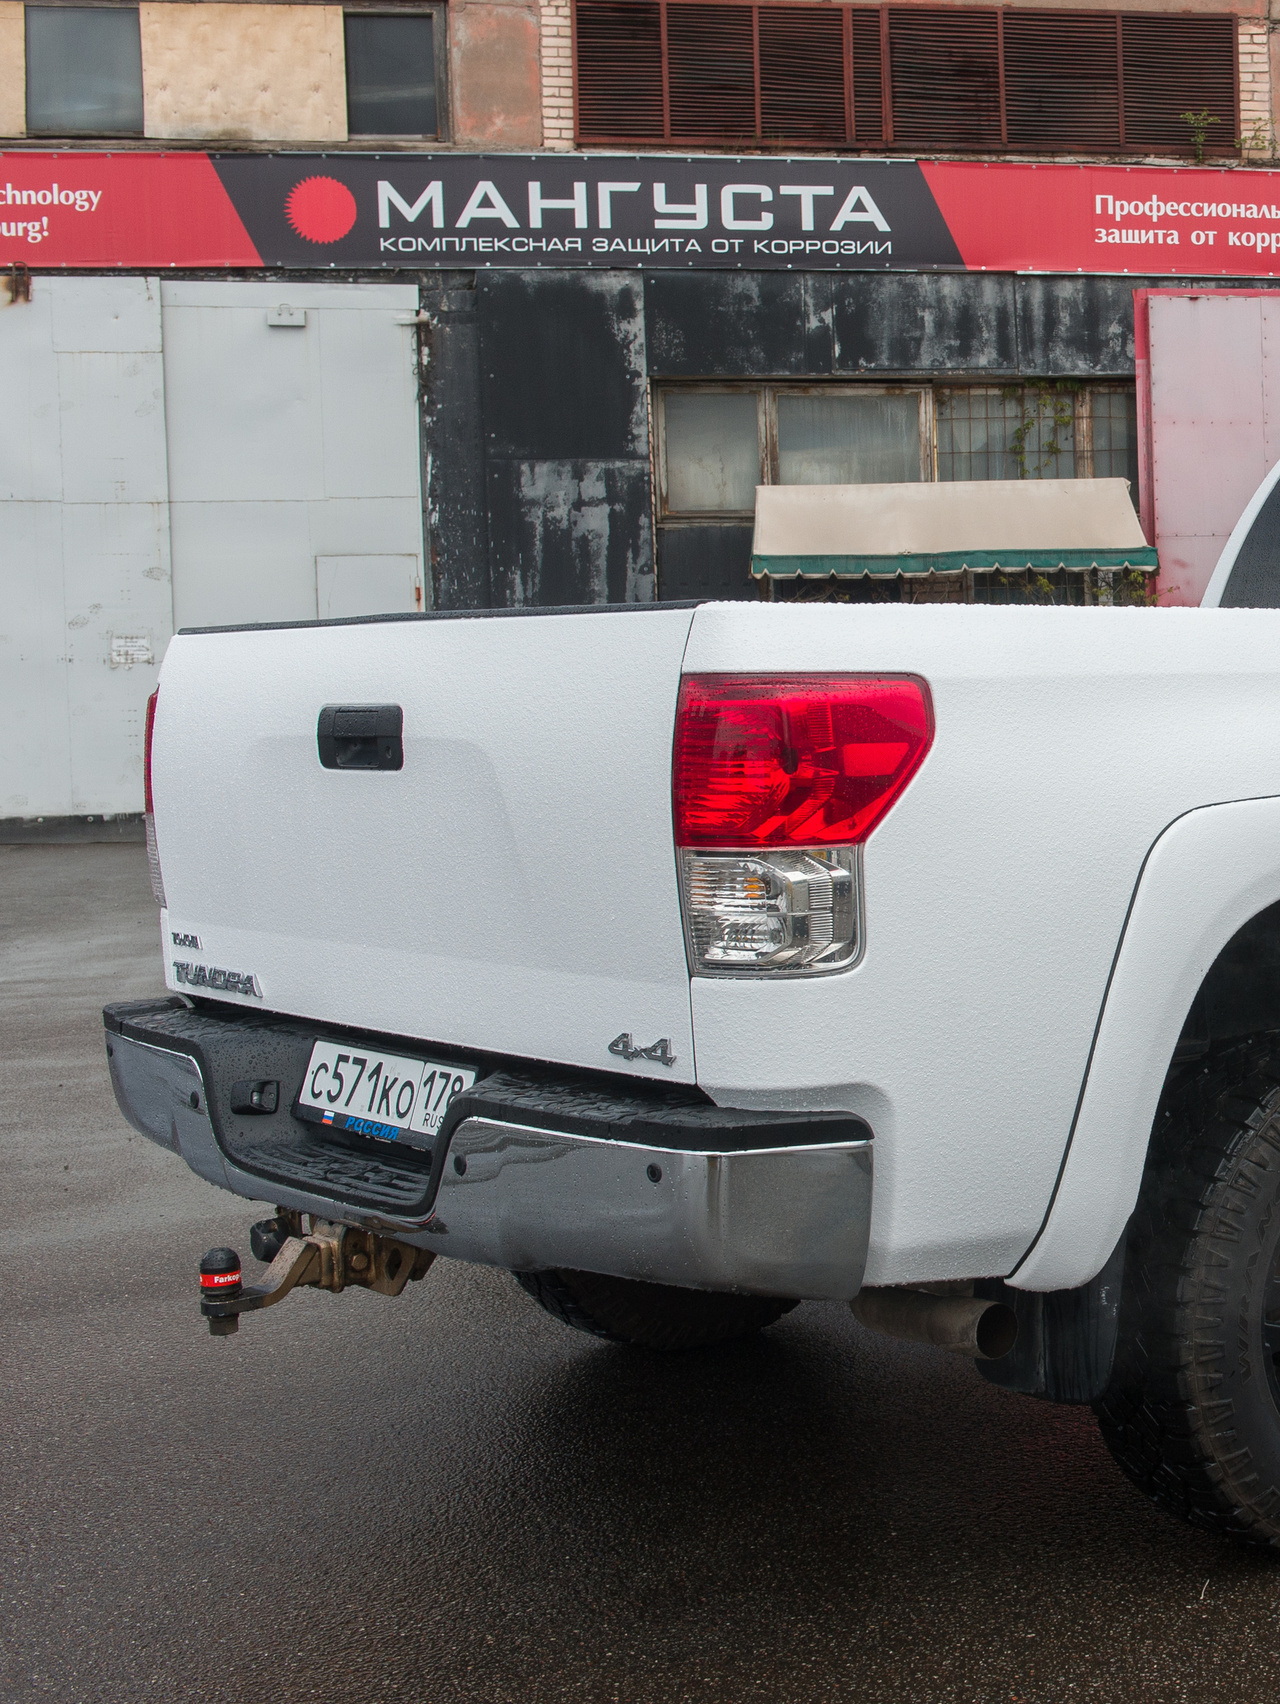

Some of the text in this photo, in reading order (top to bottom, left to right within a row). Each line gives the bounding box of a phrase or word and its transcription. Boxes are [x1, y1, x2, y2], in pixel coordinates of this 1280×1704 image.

[376, 180, 892, 232] МАНГУСТА
[0, 216, 49, 243] urg!
[1094, 228, 1180, 245] защита
[1190, 230, 1218, 246] от
[379, 237, 892, 255] КОМПЛЕКСНАЯ ЗАЩИТА ОТ КОРРОЗИИ
[173, 960, 263, 998] TUNDRA
[345, 1116, 400, 1140] РОССИЯ
